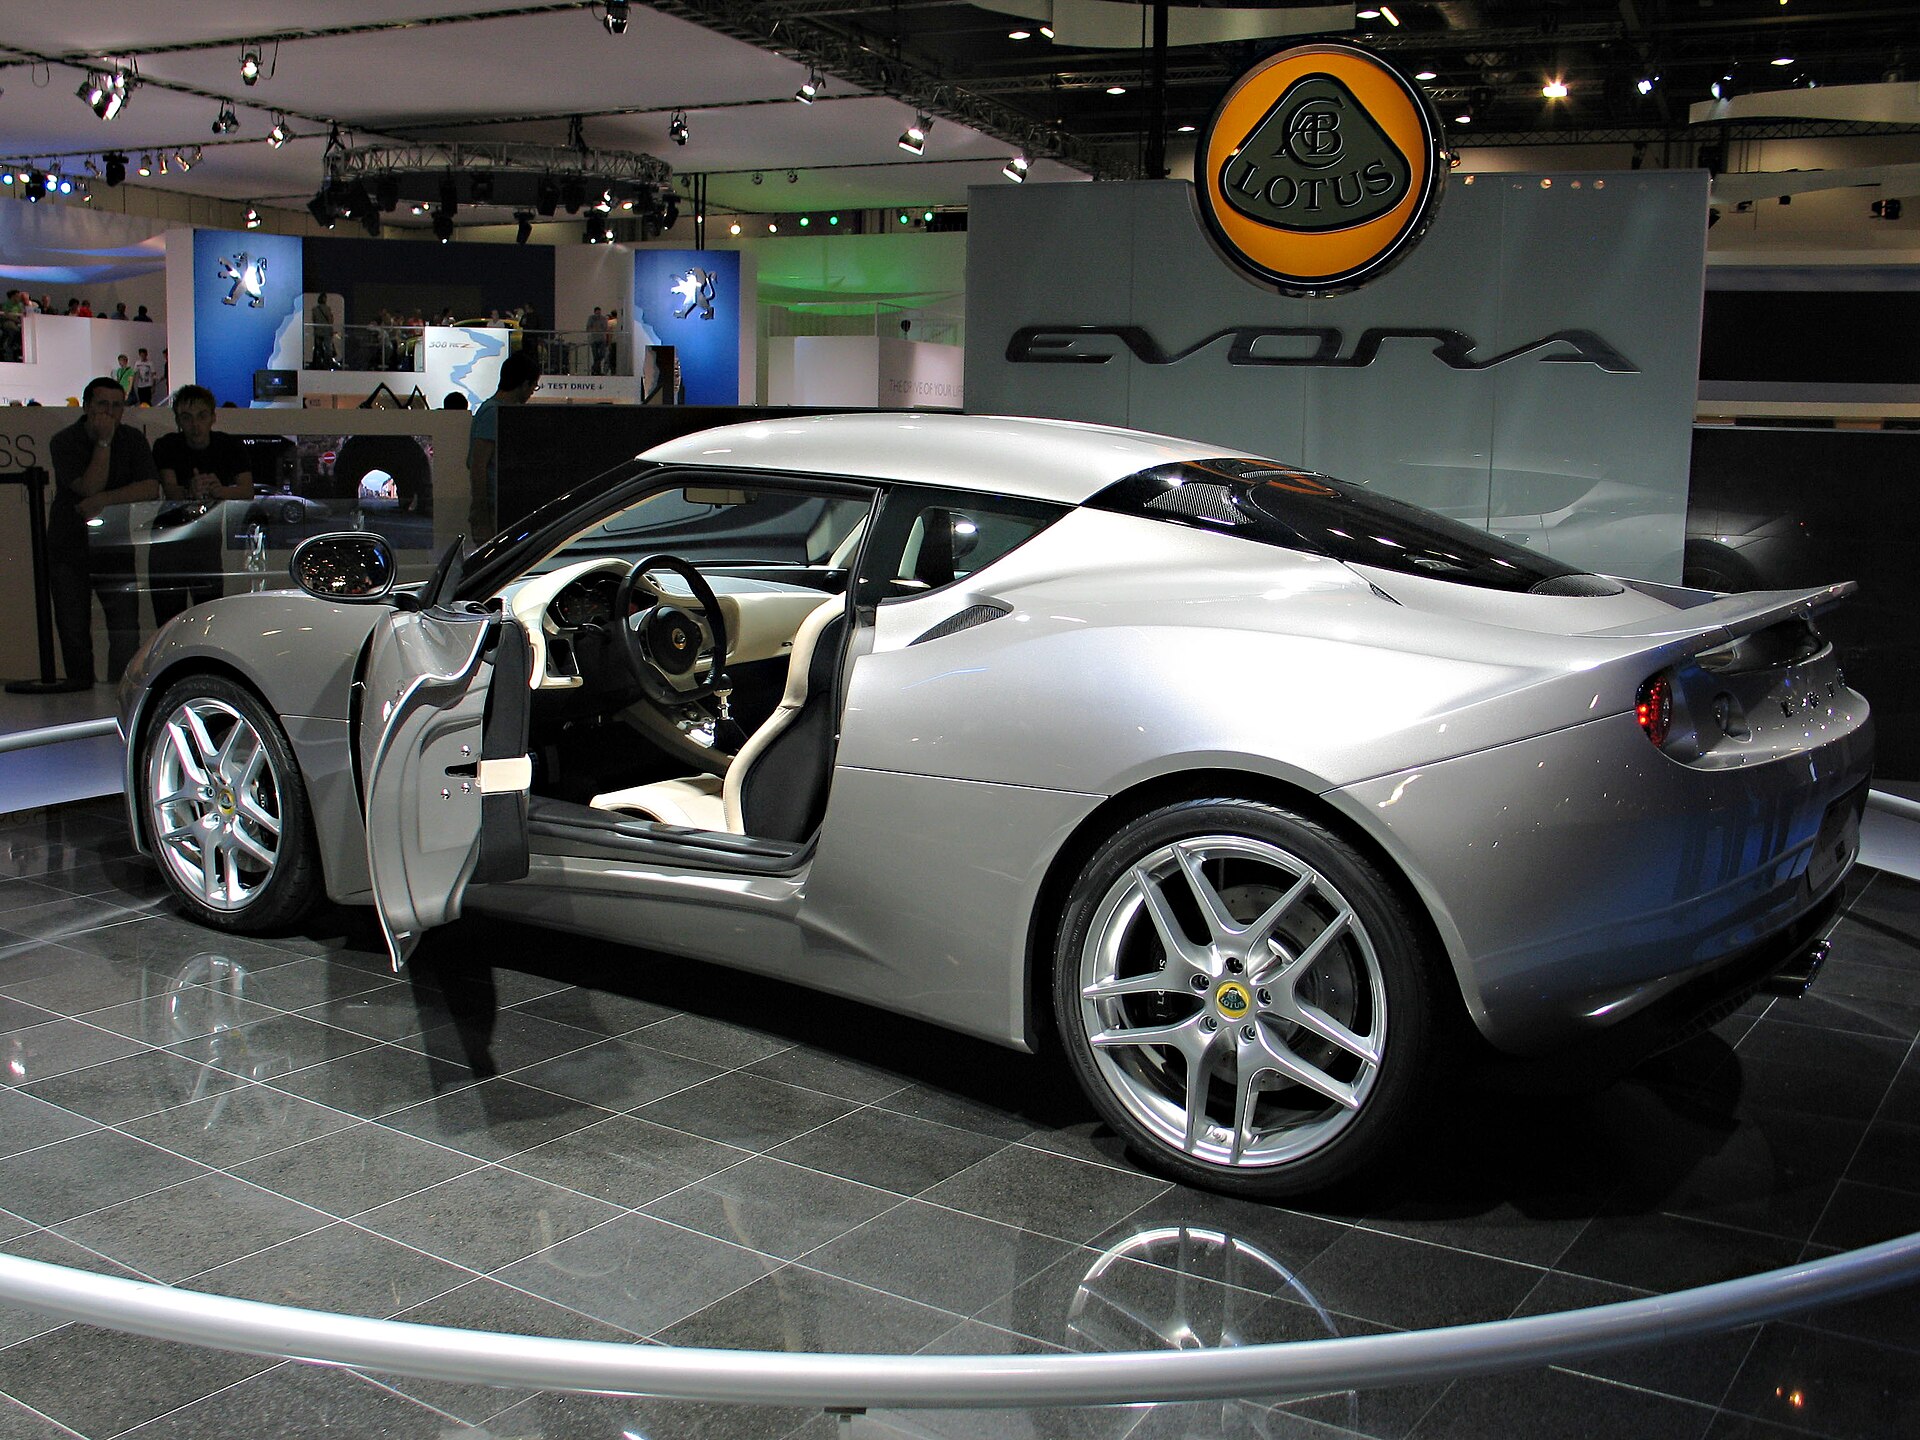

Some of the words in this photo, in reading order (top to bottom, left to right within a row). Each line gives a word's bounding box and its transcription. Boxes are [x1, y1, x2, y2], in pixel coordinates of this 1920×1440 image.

[1231, 158, 1396, 212] LOTUS
[1004, 324, 1642, 374] EVORA
[548, 382, 569, 390] TEST
[570, 382, 596, 390] DRIVE
